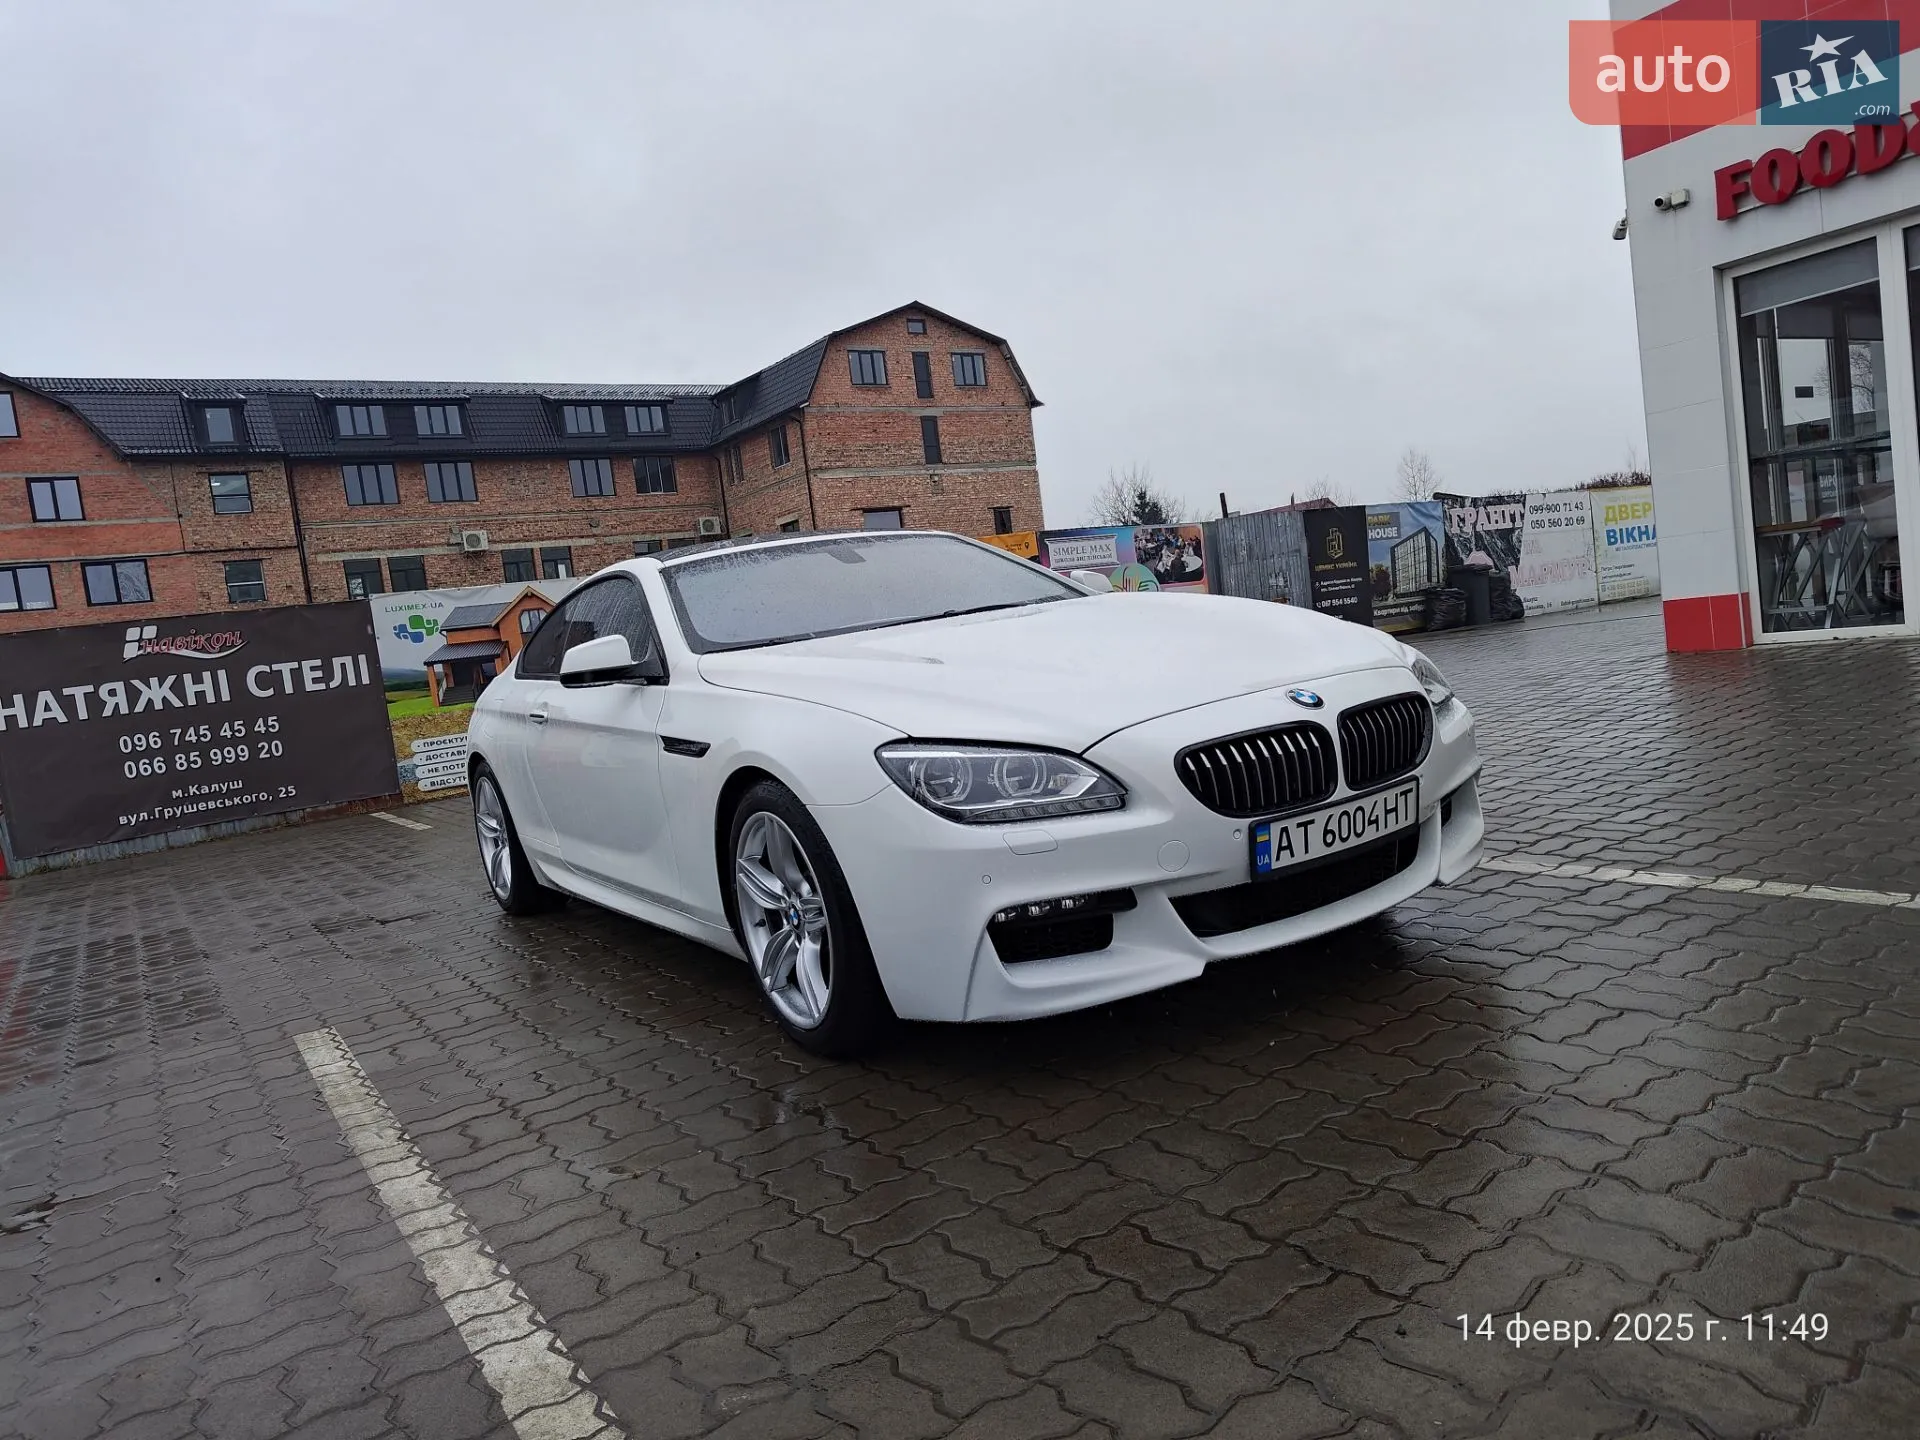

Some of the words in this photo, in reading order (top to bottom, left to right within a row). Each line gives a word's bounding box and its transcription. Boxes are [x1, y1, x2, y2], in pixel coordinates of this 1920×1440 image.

[1563, 503, 1572, 512] 71
[1574, 502, 1584, 511] 43
[1368, 514, 1391, 526] PARK
[1449, 503, 1525, 534] ГРАНІТ
[1530, 519, 1545, 529] 050
[1548, 518, 1562, 528] 560
[1565, 517, 1574, 527] 20
[1576, 516, 1585, 525] 69
[1368, 527, 1398, 539] HOUSE
[1053, 546, 1087, 556] SIMPLE
[1090, 544, 1112, 553] MAX
[0, 669, 231, 731] НАТЯЖНІ
[246, 654, 370, 698] СТЕЛІ
[119, 731, 162, 753] 096
[170, 725, 211, 746] 745
[220, 720, 246, 739] 45
[254, 716, 279, 734] 45
[124, 756, 166, 779] 066
[175, 752, 202, 771] 85
[210, 744, 250, 766] 999
[258, 740, 283, 759] 20
[172, 779, 243, 799] м.Калуш
[118, 793, 273, 826] вул.Грушевського,
[278, 785, 296, 798] 25
[1275, 819, 1315, 862] AT
[1257, 855, 1270, 866] UA
